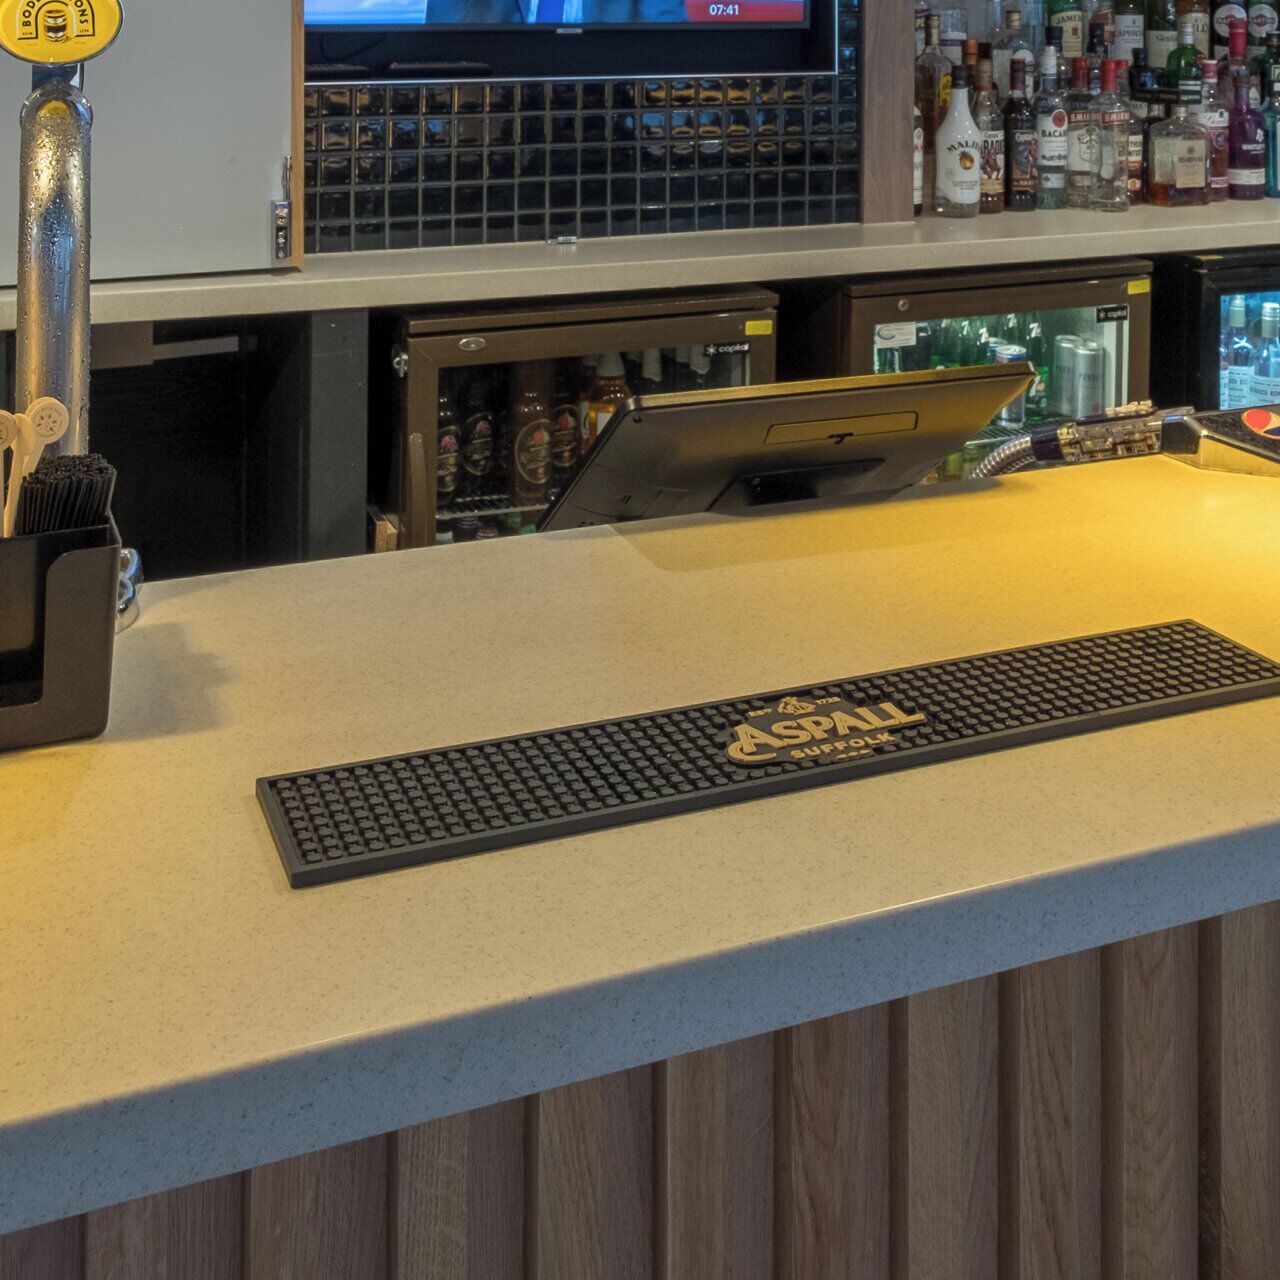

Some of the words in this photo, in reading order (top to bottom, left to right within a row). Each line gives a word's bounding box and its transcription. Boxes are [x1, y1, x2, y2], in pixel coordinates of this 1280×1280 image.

[709, 4, 739, 16] 07:41
[1055, 14, 1082, 25] JAMES
[947, 140, 980, 154] MALI
[718, 342, 750, 353] capital
[814, 695, 841, 705] 1728
[727, 701, 926, 764] ASPALL
[790, 731, 897, 760] SUFFOLK
